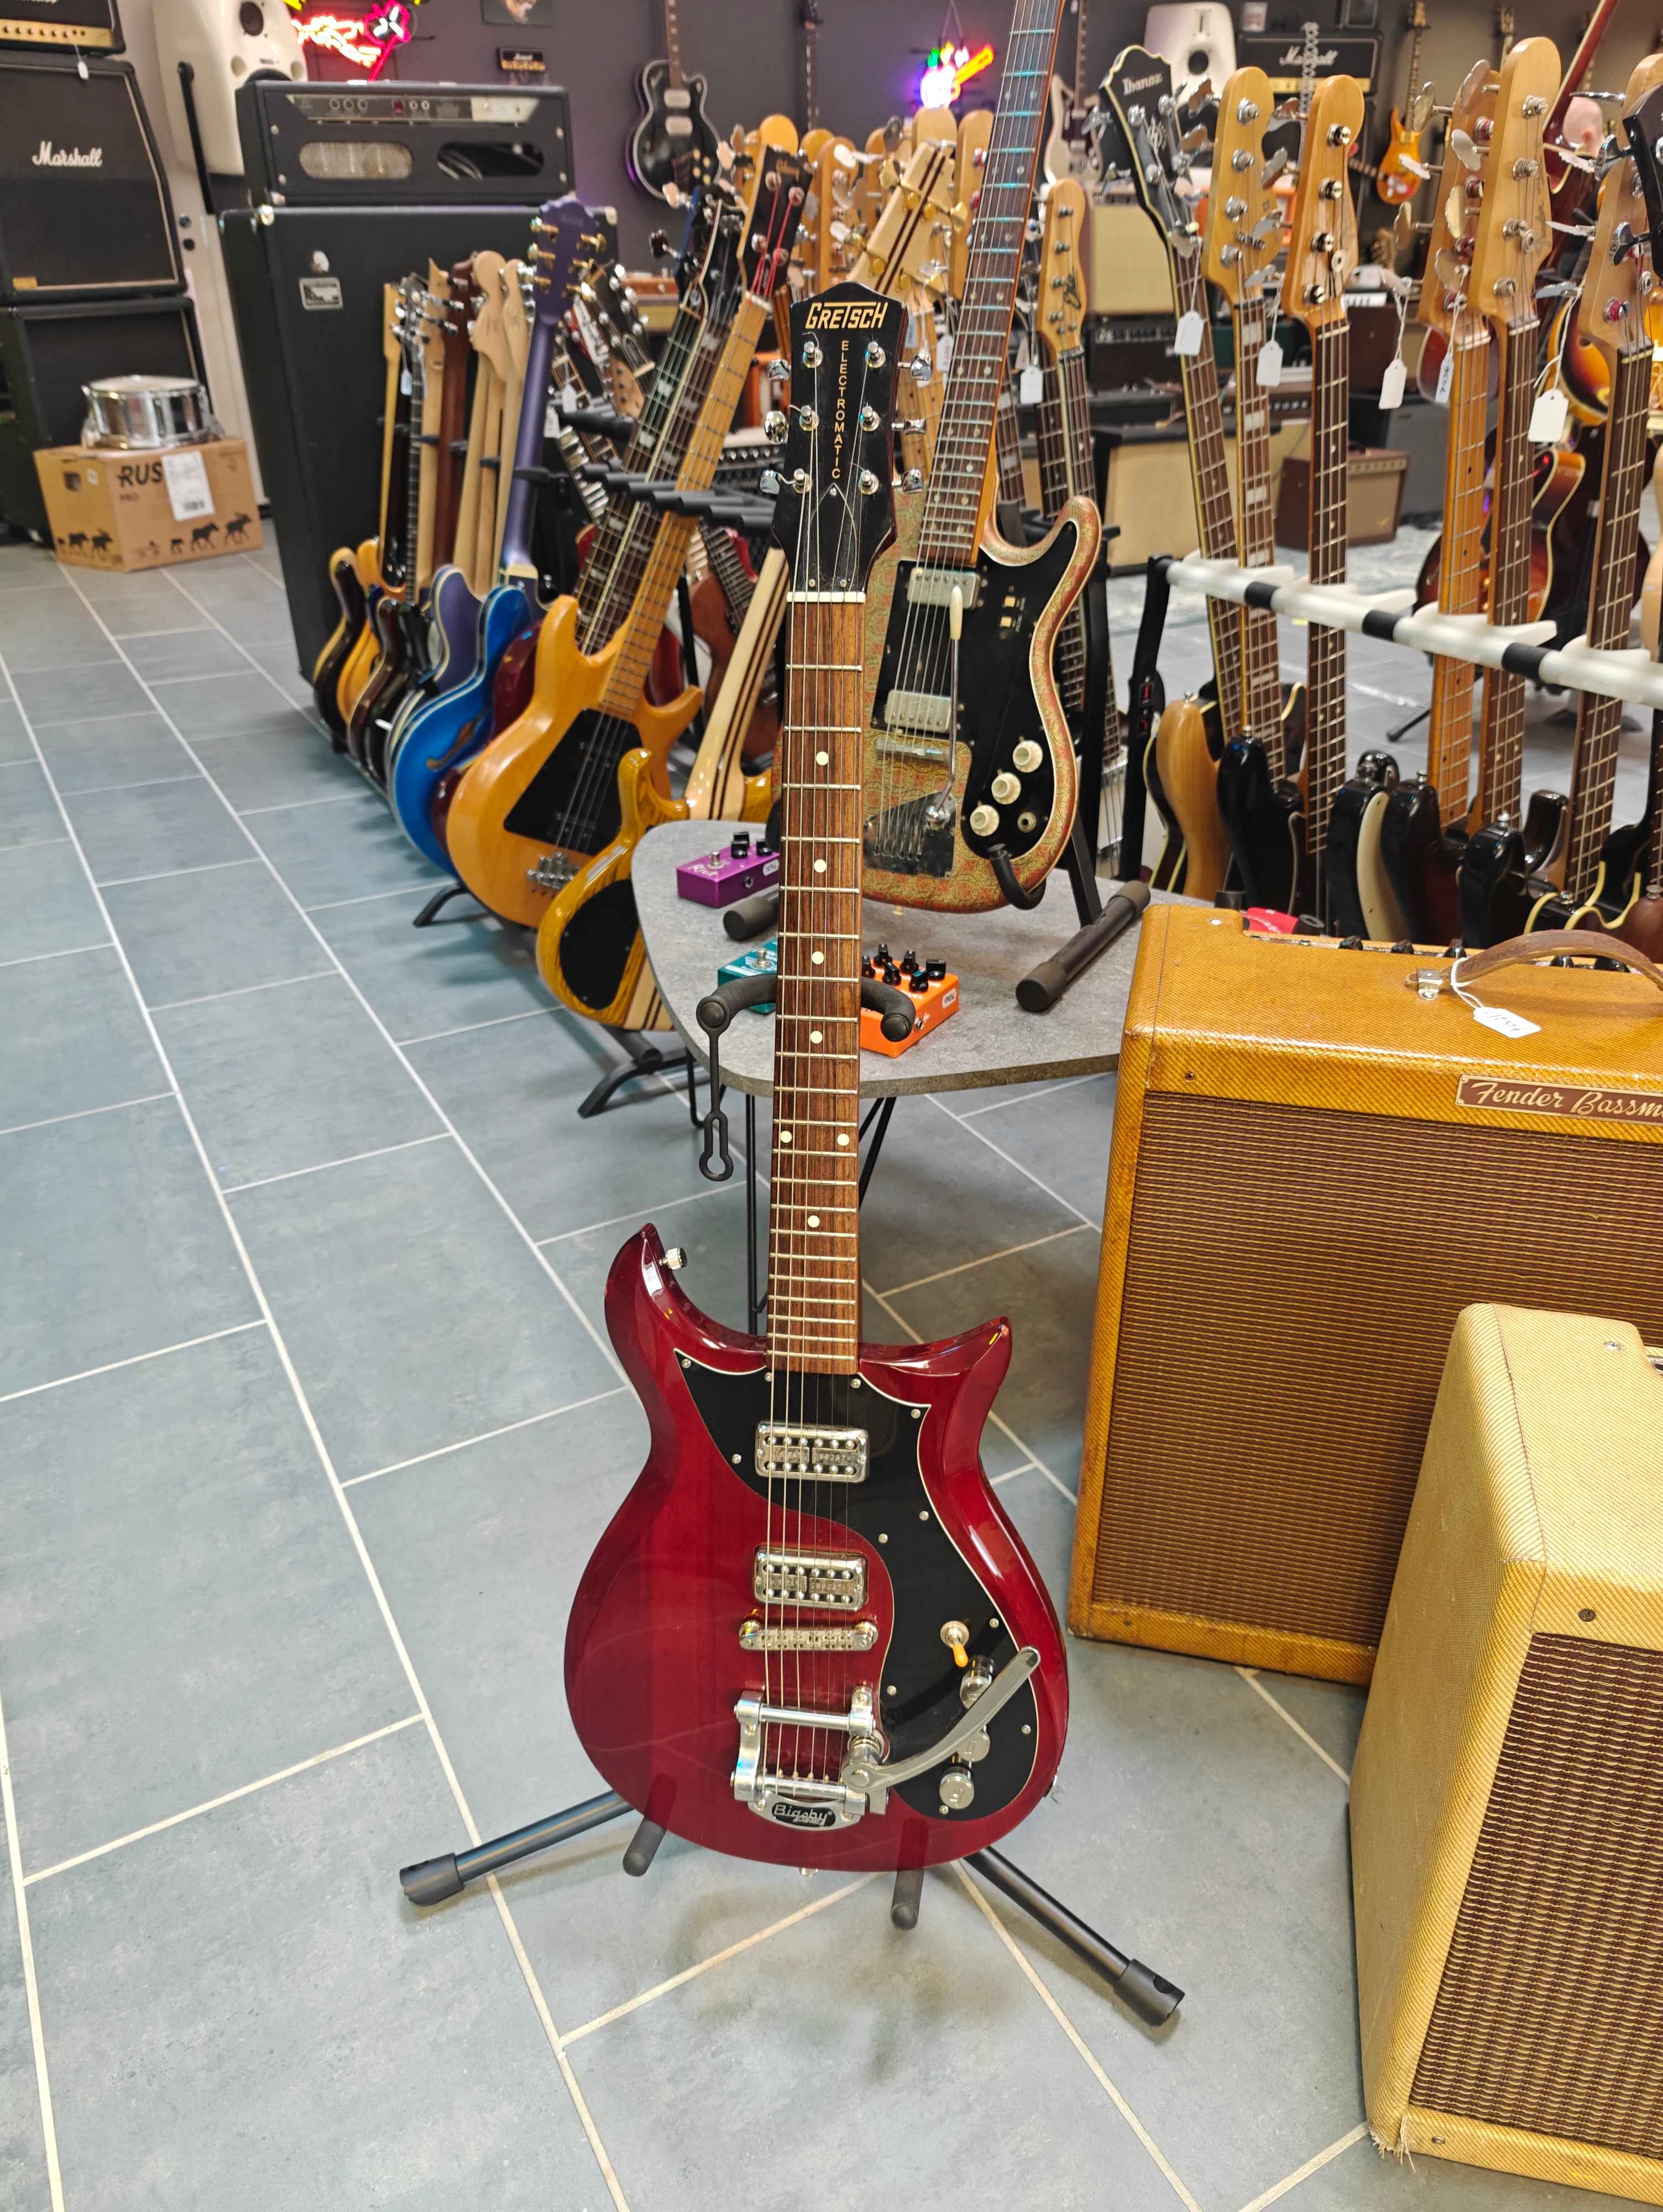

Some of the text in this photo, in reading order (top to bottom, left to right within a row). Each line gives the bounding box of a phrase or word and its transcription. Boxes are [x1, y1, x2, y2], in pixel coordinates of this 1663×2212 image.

[1279, 46, 1338, 66] Maall
[1122, 73, 1163, 96] Ibanez
[32, 140, 102, 167] Marshall
[805, 301, 888, 330] GRETSCH
[831, 340, 850, 479] ELECTROMATIC
[1470, 1081, 1565, 1109] Fender
[773, 1804, 828, 1826] Bigsby
